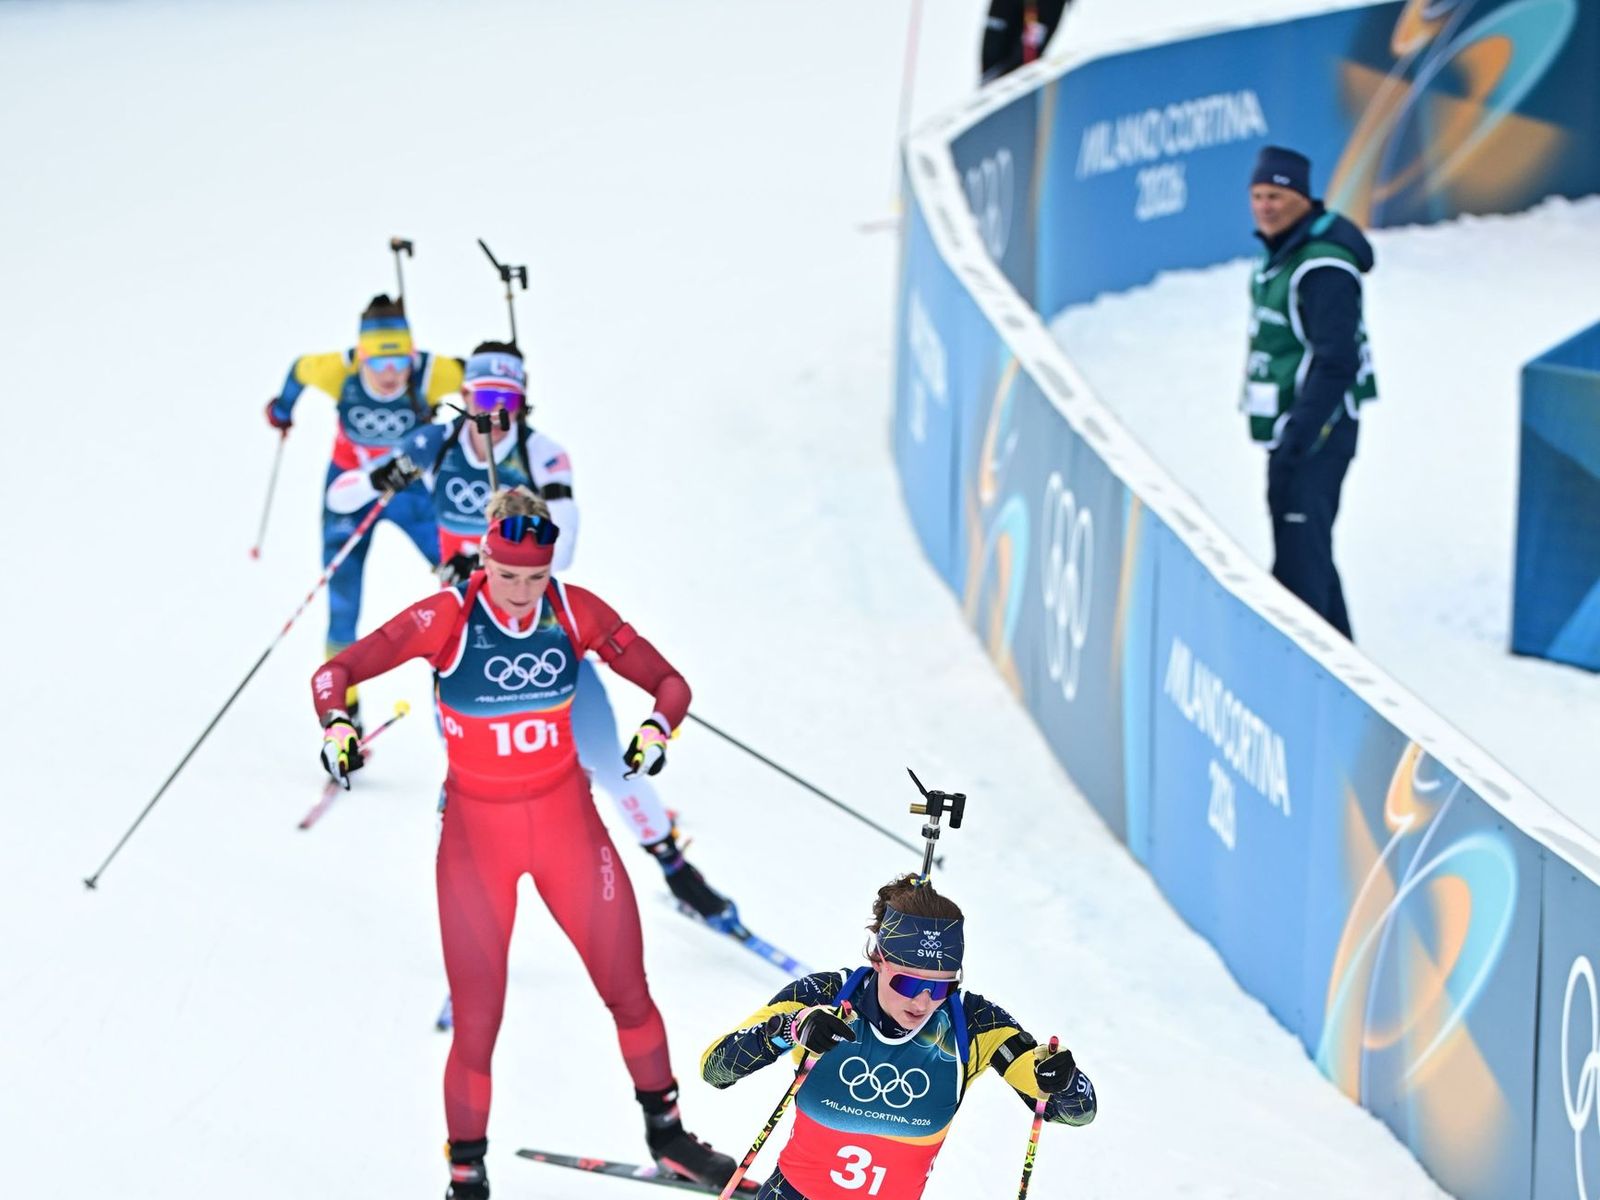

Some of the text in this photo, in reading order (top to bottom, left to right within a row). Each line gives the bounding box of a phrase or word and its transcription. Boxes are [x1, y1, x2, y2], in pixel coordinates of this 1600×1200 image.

[917, 948, 943, 959] SWE
[820, 1099, 931, 1126] MILANO CORTINA 2026
